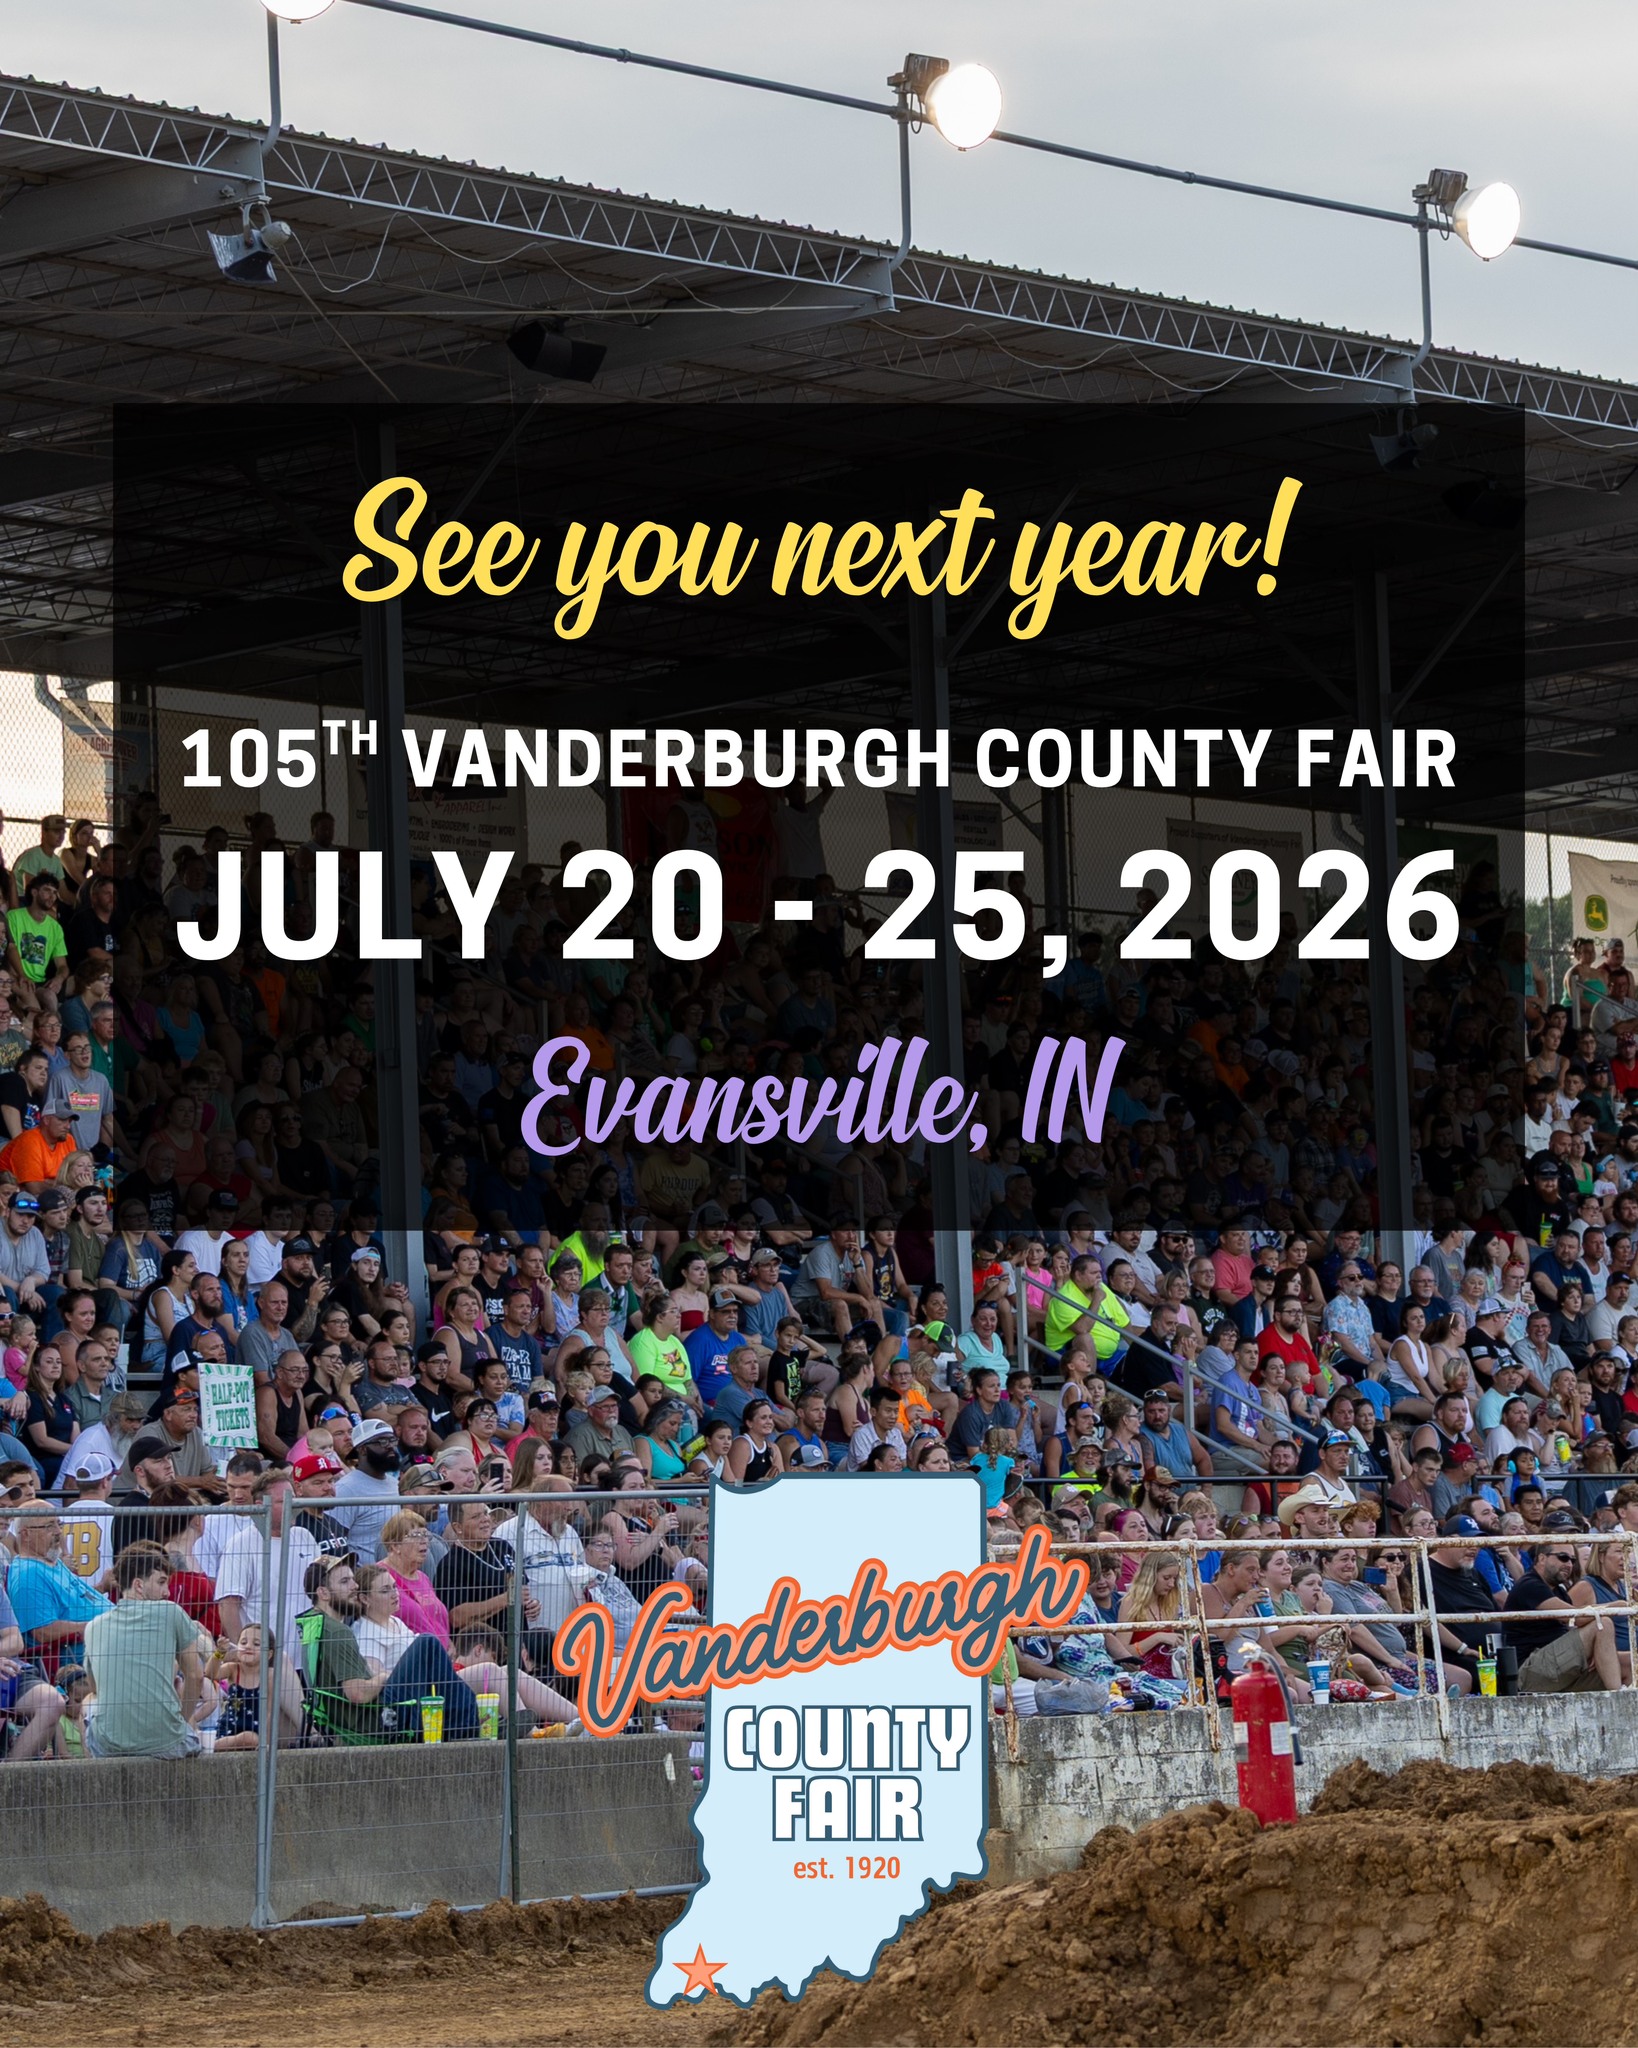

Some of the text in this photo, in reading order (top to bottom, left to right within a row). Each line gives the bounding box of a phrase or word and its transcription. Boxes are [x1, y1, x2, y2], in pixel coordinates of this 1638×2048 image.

[443, 800, 485, 815] APPAREL
[1169, 826, 1190, 839] Proud
[1221, 832, 1229, 842] of
[211, 1380, 249, 1405] HALF-POT
[216, 1407, 250, 1431] TICKETS
